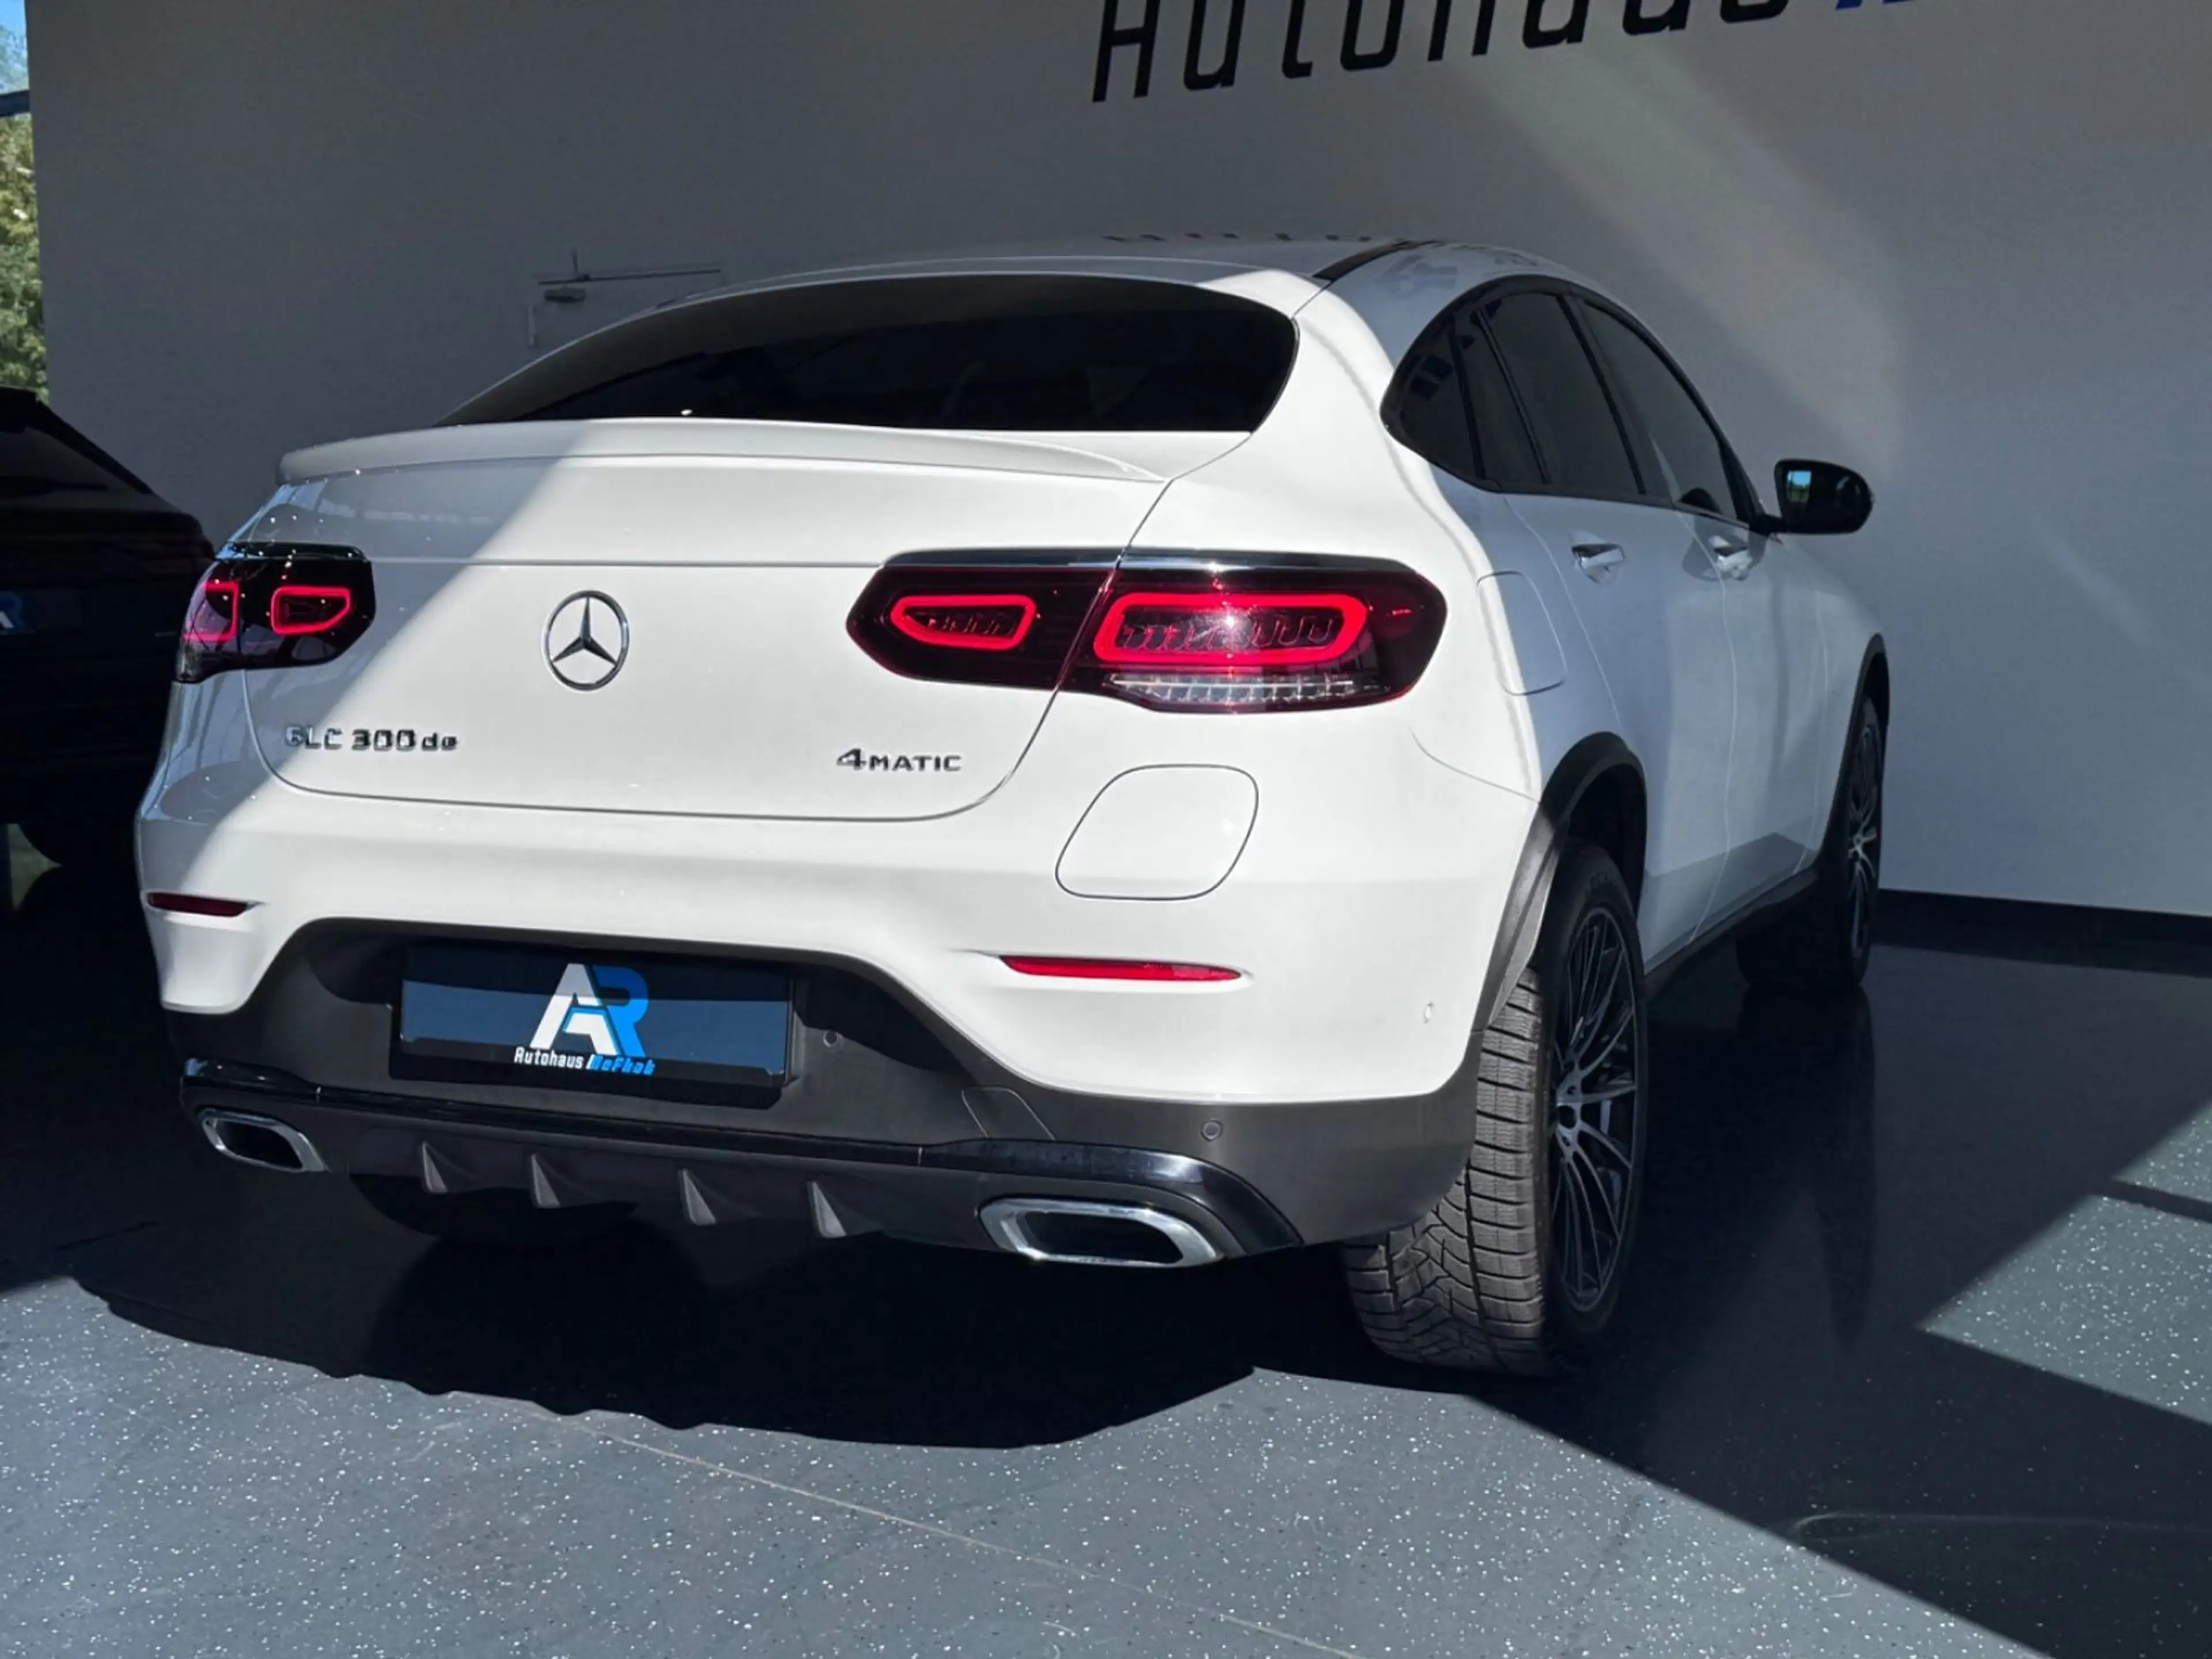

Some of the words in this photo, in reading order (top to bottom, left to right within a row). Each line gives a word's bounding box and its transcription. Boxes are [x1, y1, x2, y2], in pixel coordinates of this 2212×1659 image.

[284, 725, 343, 749] GLC
[351, 729, 415, 751] 300
[421, 732, 458, 750] de
[836, 748, 961, 771] 4MATIC
[529, 963, 649, 1056] AR
[514, 1046, 584, 1069] Autohaus
